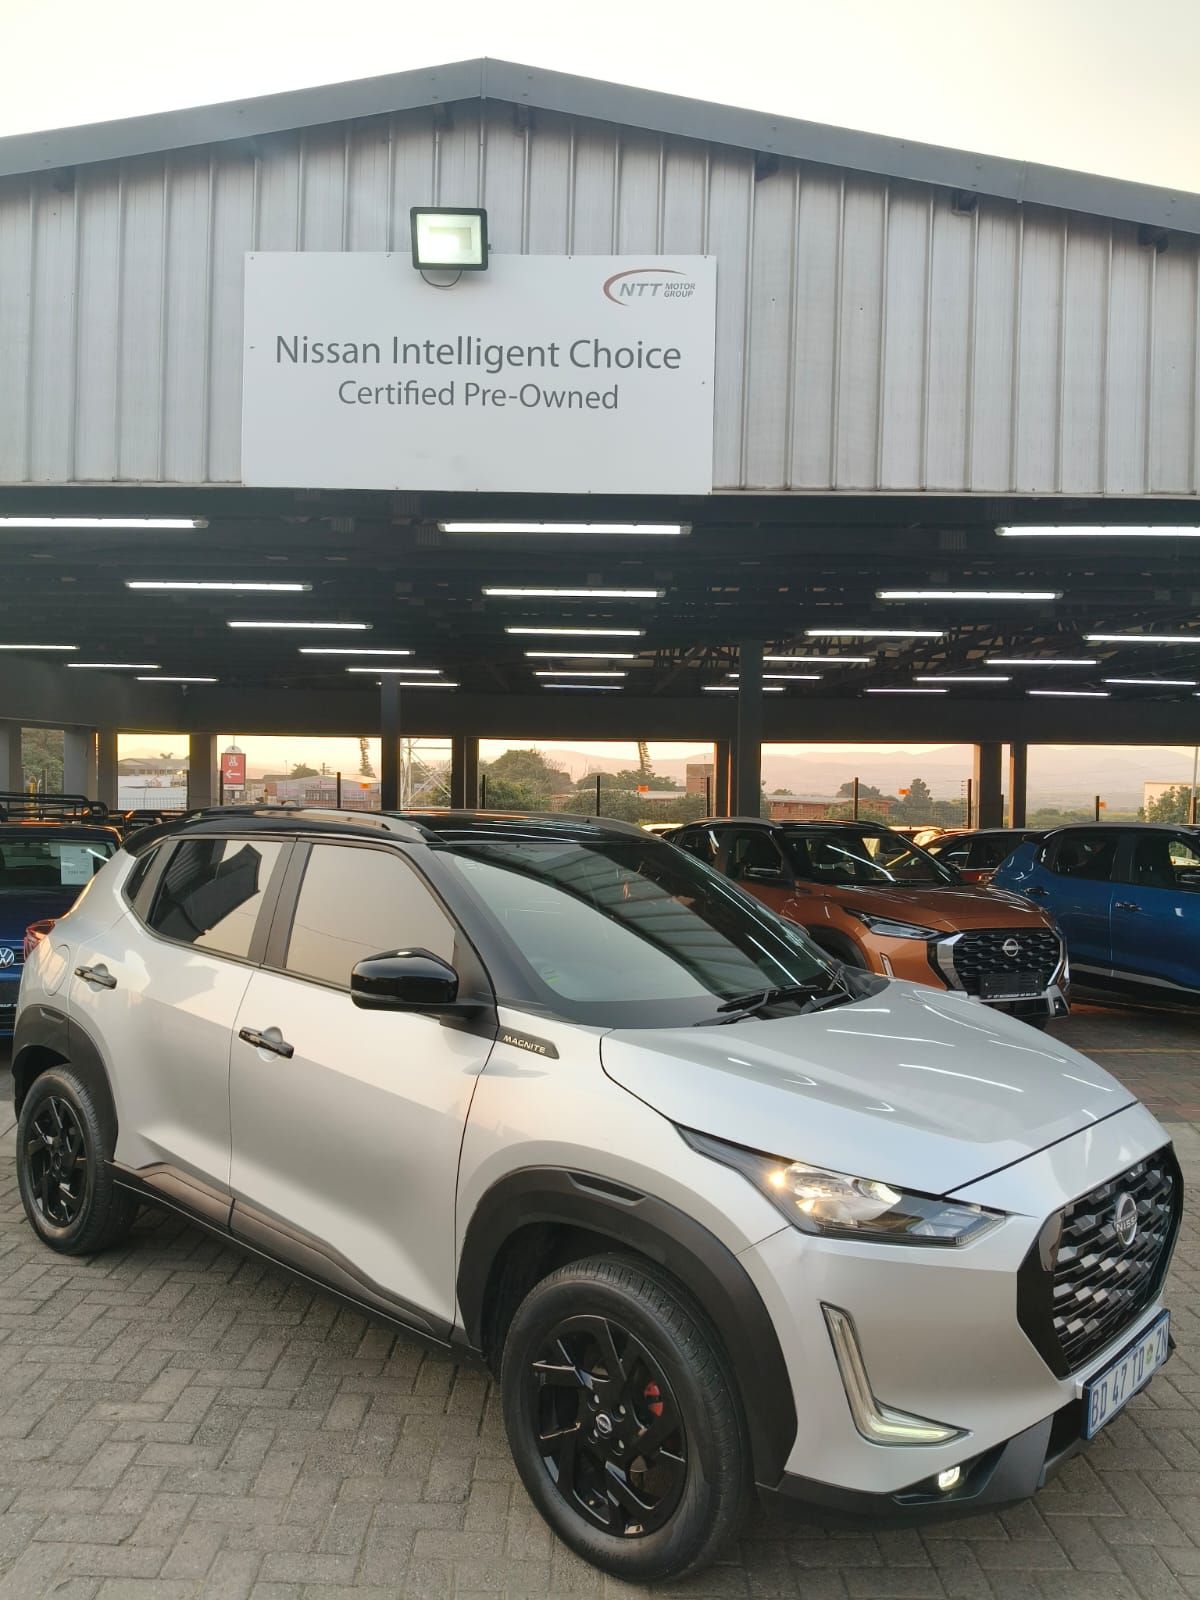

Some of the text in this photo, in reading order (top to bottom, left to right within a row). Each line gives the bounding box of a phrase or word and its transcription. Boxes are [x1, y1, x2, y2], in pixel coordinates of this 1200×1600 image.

[619, 283, 663, 297] NTT
[663, 290, 694, 298] GROUP
[664, 282, 696, 290] MOTOR
[276, 335, 682, 374] Nissan Intelligent Choice
[338, 379, 619, 410] Certified Pre-Owned
[502, 1034, 546, 1054] MAGNITE
[1091, 1381, 1108, 1428] BD
[1112, 1362, 1128, 1406] 47
